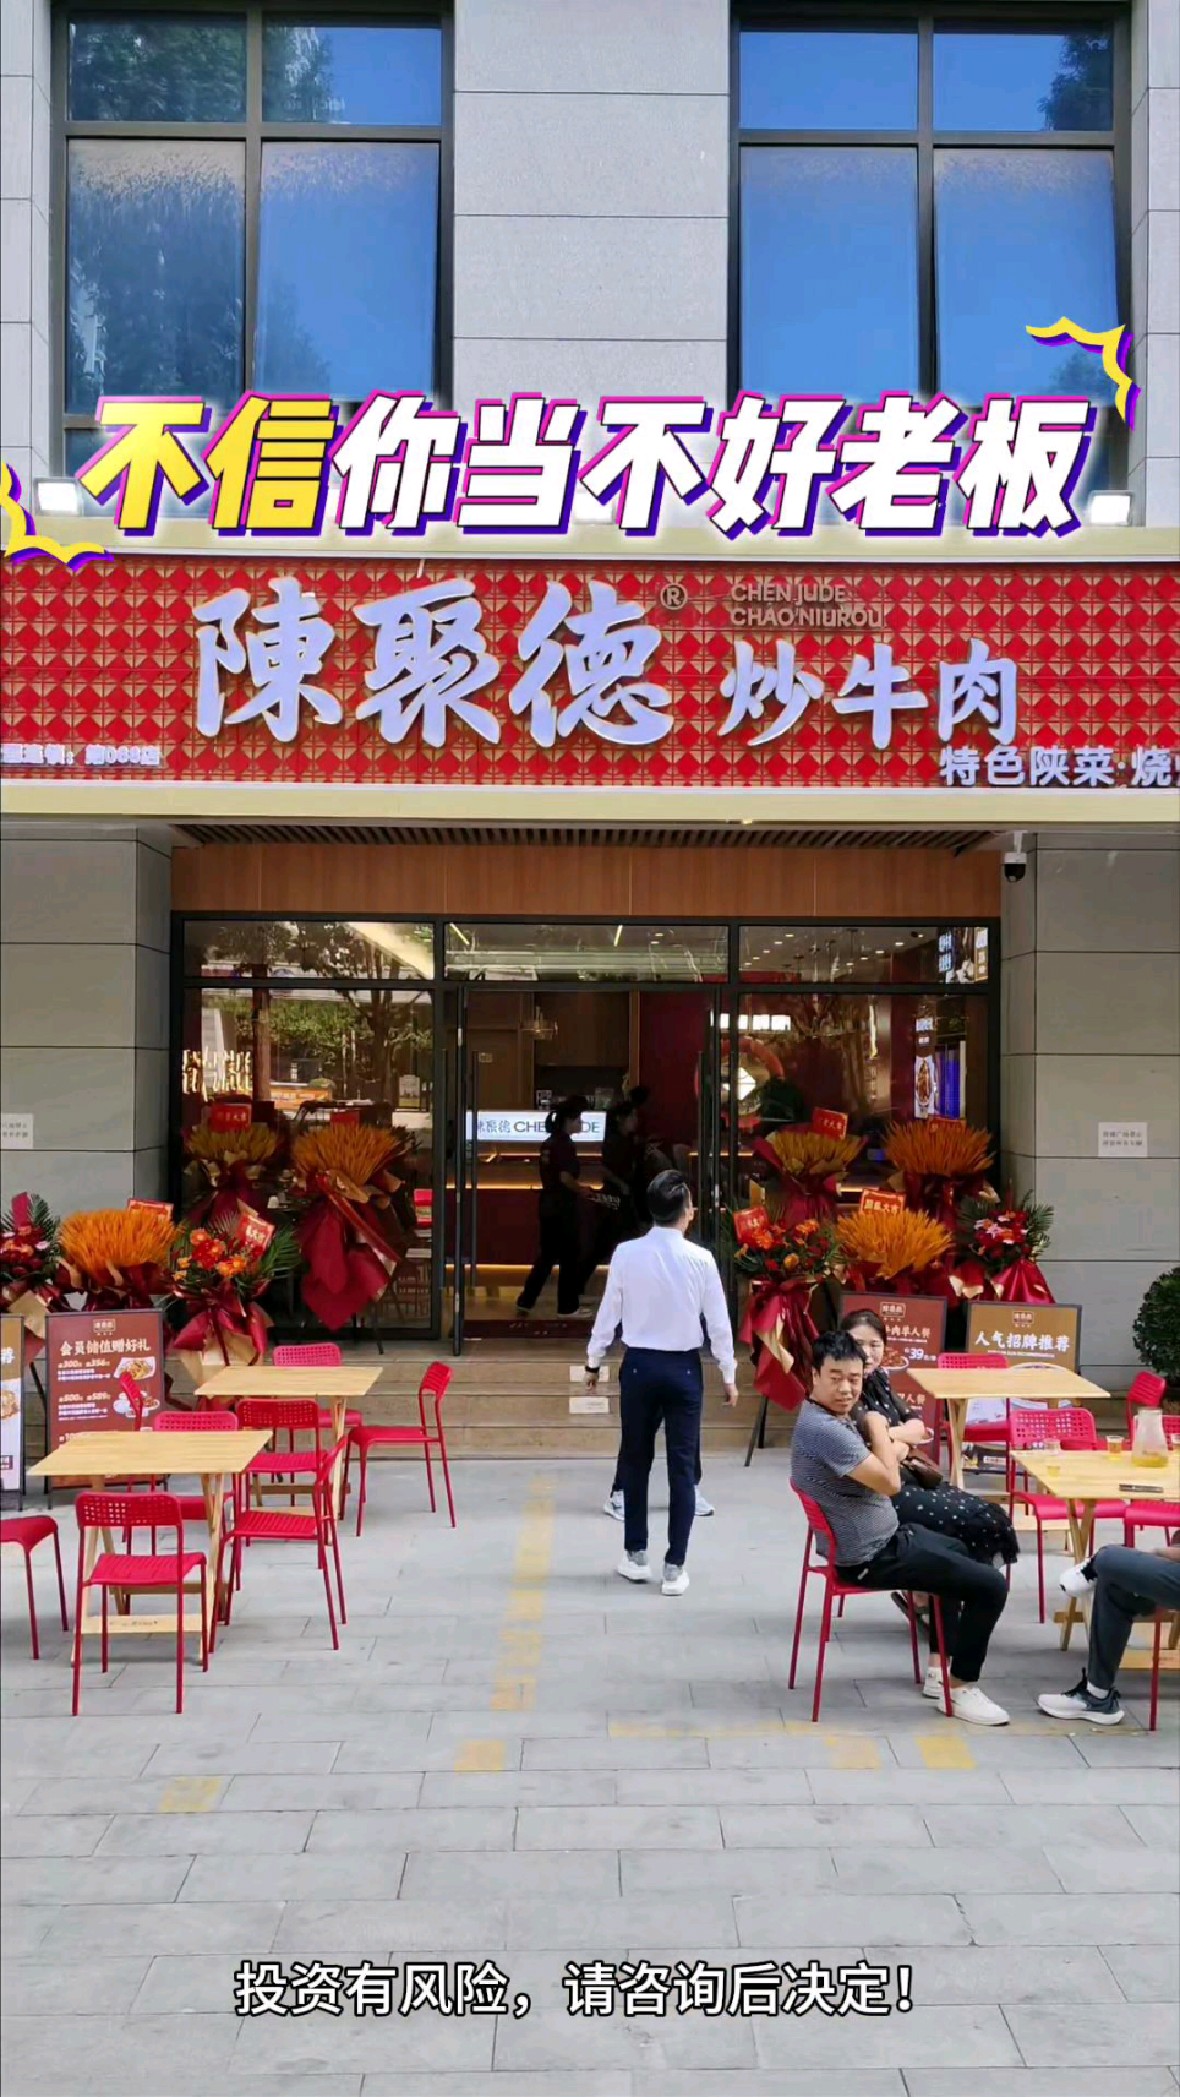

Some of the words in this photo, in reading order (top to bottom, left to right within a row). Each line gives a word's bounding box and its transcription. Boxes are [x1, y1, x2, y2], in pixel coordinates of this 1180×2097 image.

[731, 583, 791, 602] CHEN
[795, 583, 847, 605] JUDE
[730, 608, 795, 627] CHAO
[798, 608, 884, 628] NIUROU
[718, 638, 1018, 749] 炒牛肉
[939, 746, 1180, 786] 特色陕菜·烧
